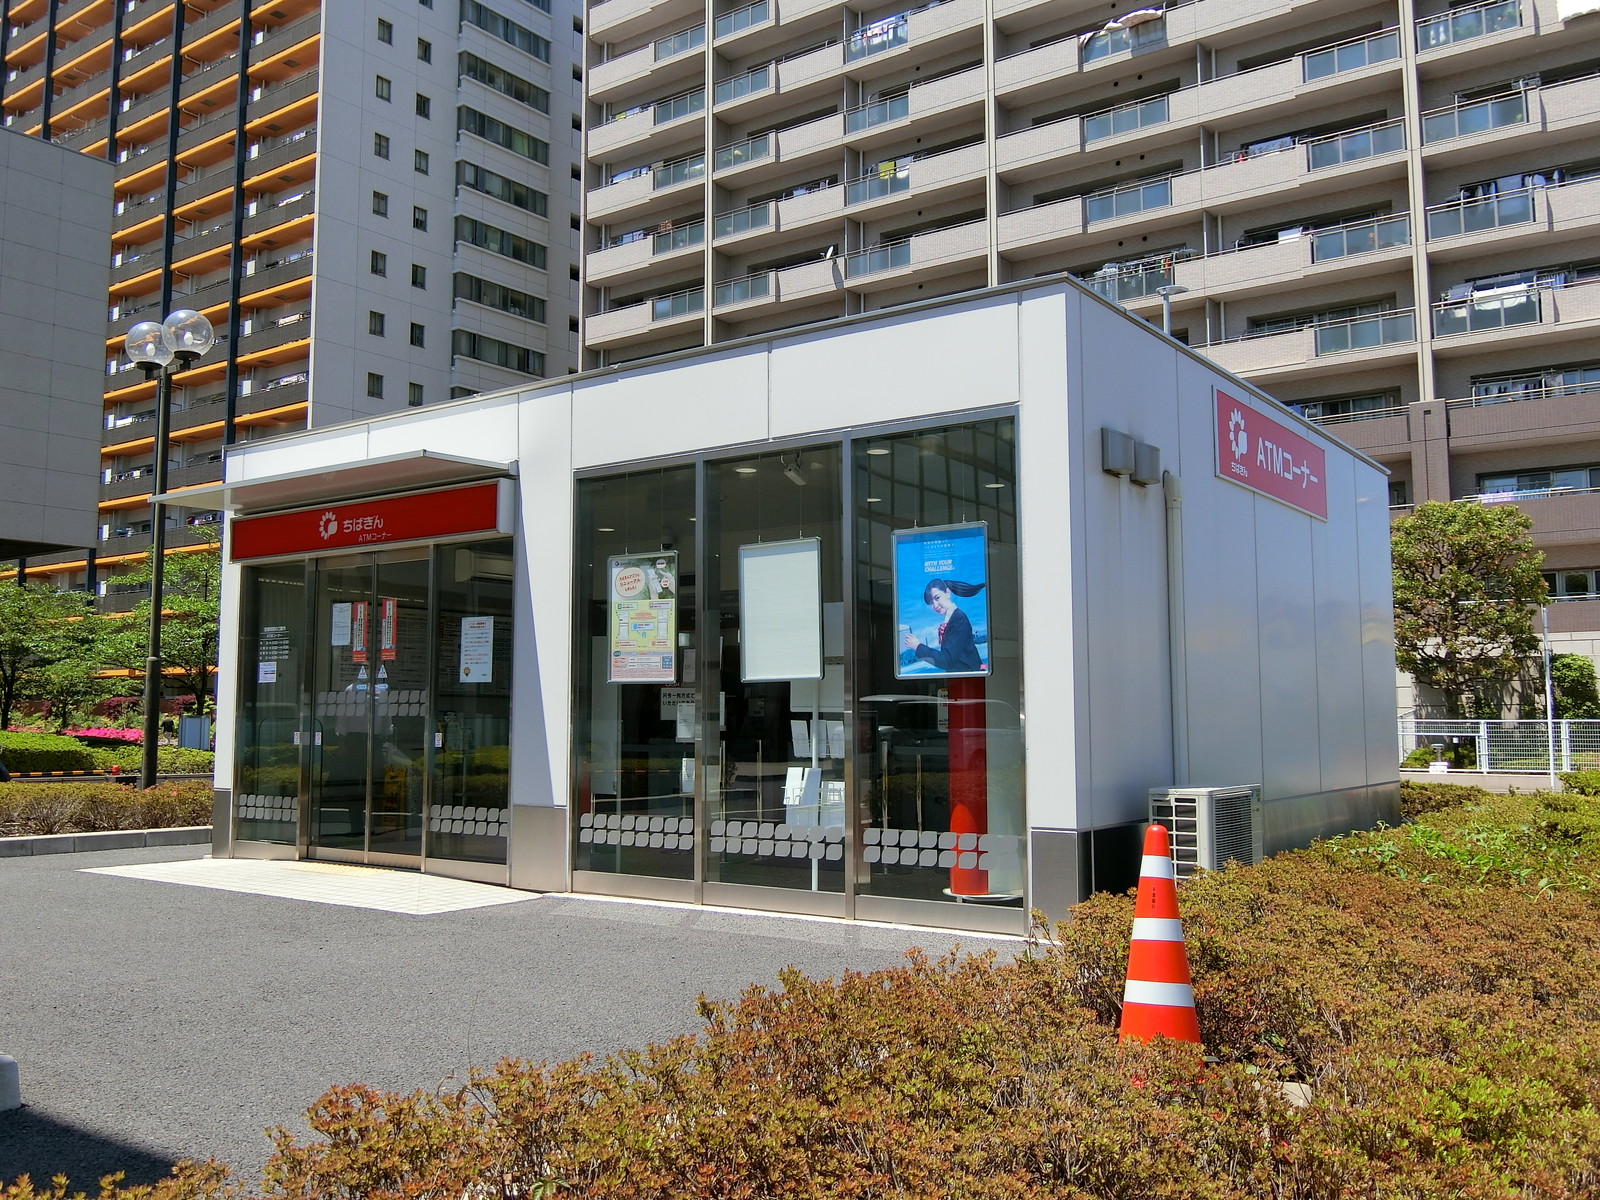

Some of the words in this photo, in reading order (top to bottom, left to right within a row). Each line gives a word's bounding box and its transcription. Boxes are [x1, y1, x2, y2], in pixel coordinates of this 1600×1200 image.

[1230, 461, 1248, 478] ちばぎん
[1256, 436, 1319, 489] ATMコーナー
[342, 515, 384, 533] ちばぎん
[358, 531, 392, 542] ATMコーナー
